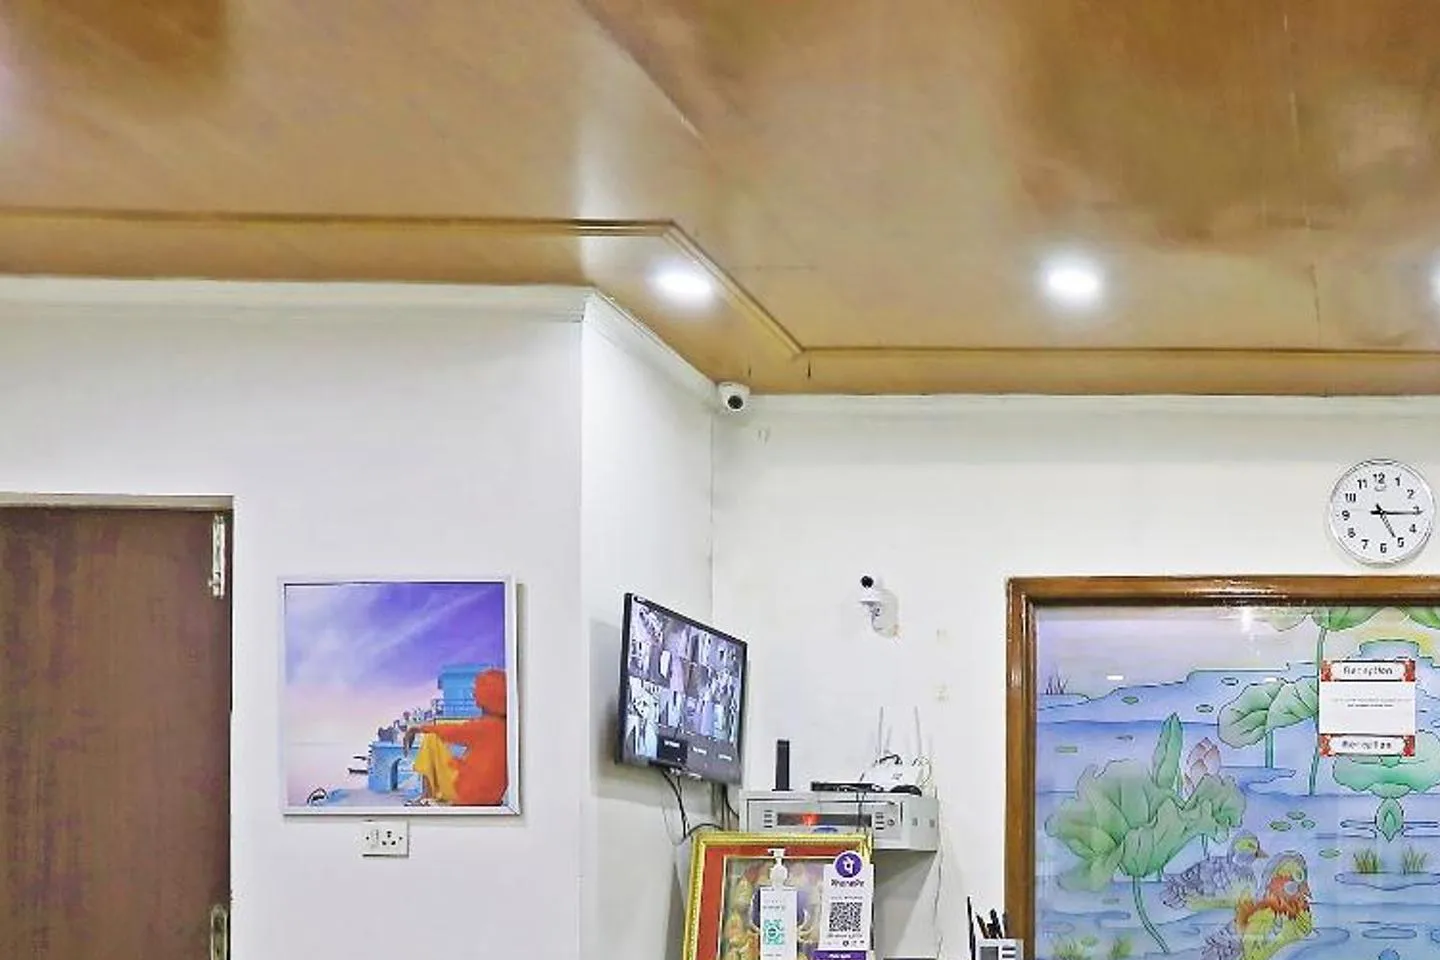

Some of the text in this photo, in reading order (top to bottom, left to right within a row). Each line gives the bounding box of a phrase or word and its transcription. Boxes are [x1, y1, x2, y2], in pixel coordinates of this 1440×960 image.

[1372, 472, 1385, 484] 12
[1394, 477, 1400, 486] 1
[1357, 479, 1368, 489] 11
[1407, 489, 1415, 499] 2
[1341, 510, 1350, 521] 9
[1347, 528, 1356, 538] 8
[1409, 524, 1417, 533] 4
[1361, 539, 1369, 549] 7
[1397, 537, 1405, 548] 5
[1380, 543, 1387, 553] 6
